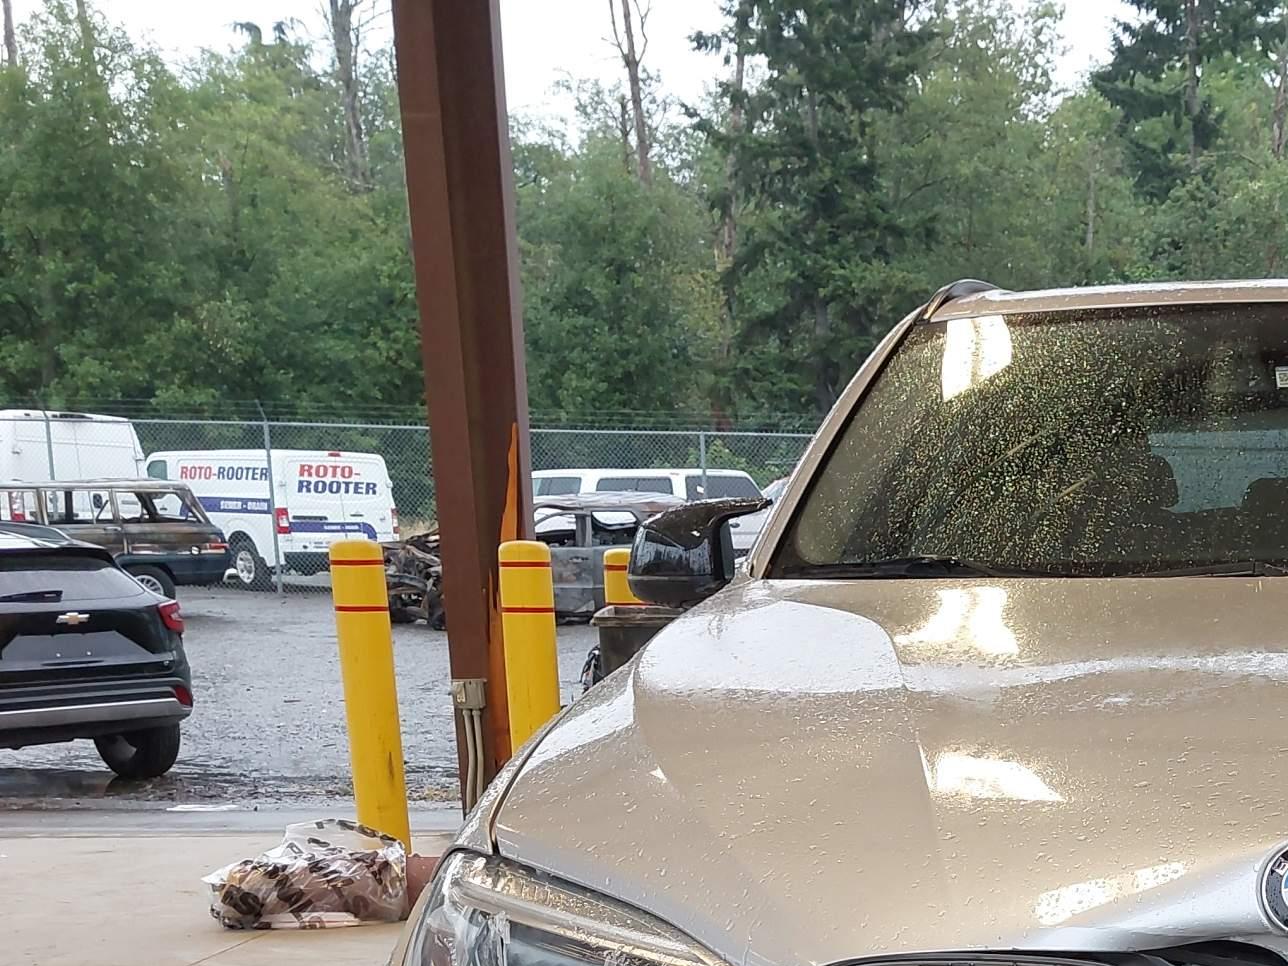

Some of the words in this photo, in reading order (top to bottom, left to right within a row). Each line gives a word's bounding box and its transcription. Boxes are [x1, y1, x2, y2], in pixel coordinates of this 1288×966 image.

[180, 465, 269, 481] ROTO-ROOTER
[298, 463, 361, 479] ROTO-
[297, 480, 378, 495] ROOTER
